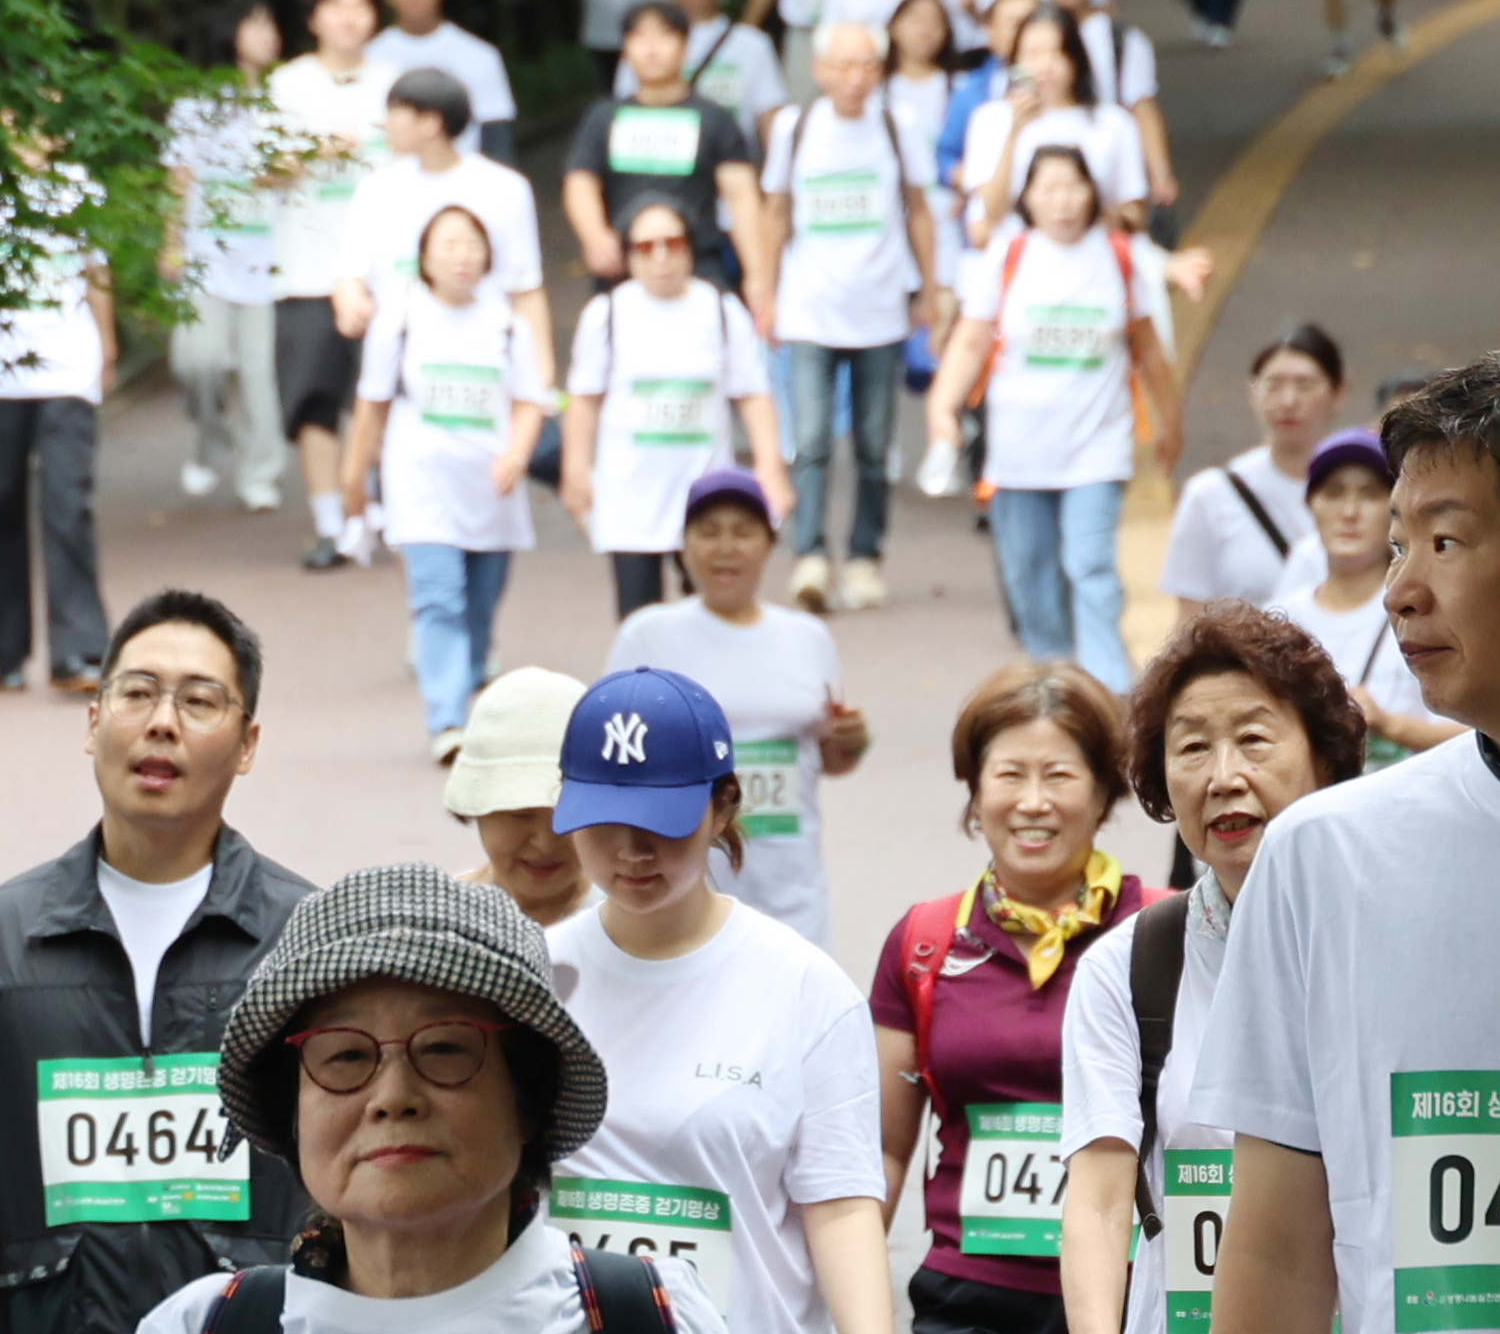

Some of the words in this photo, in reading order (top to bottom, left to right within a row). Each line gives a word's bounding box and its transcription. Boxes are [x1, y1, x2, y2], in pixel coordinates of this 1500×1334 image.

[601, 712, 648, 765] NY
[52, 1070, 100, 1091] 제16회
[171, 1066, 218, 1087] 걷기명
[694, 1062, 763, 1091] L.I.S.A
[1412, 1090, 1479, 1119] 제16회
[67, 1107, 218, 1166] 0464
[985, 1152, 1069, 1206] 047
[1177, 1164, 1224, 1185] 제16회
[587, 1191, 651, 1215] 생명존중
[654, 1197, 721, 1221] 걷기명상
